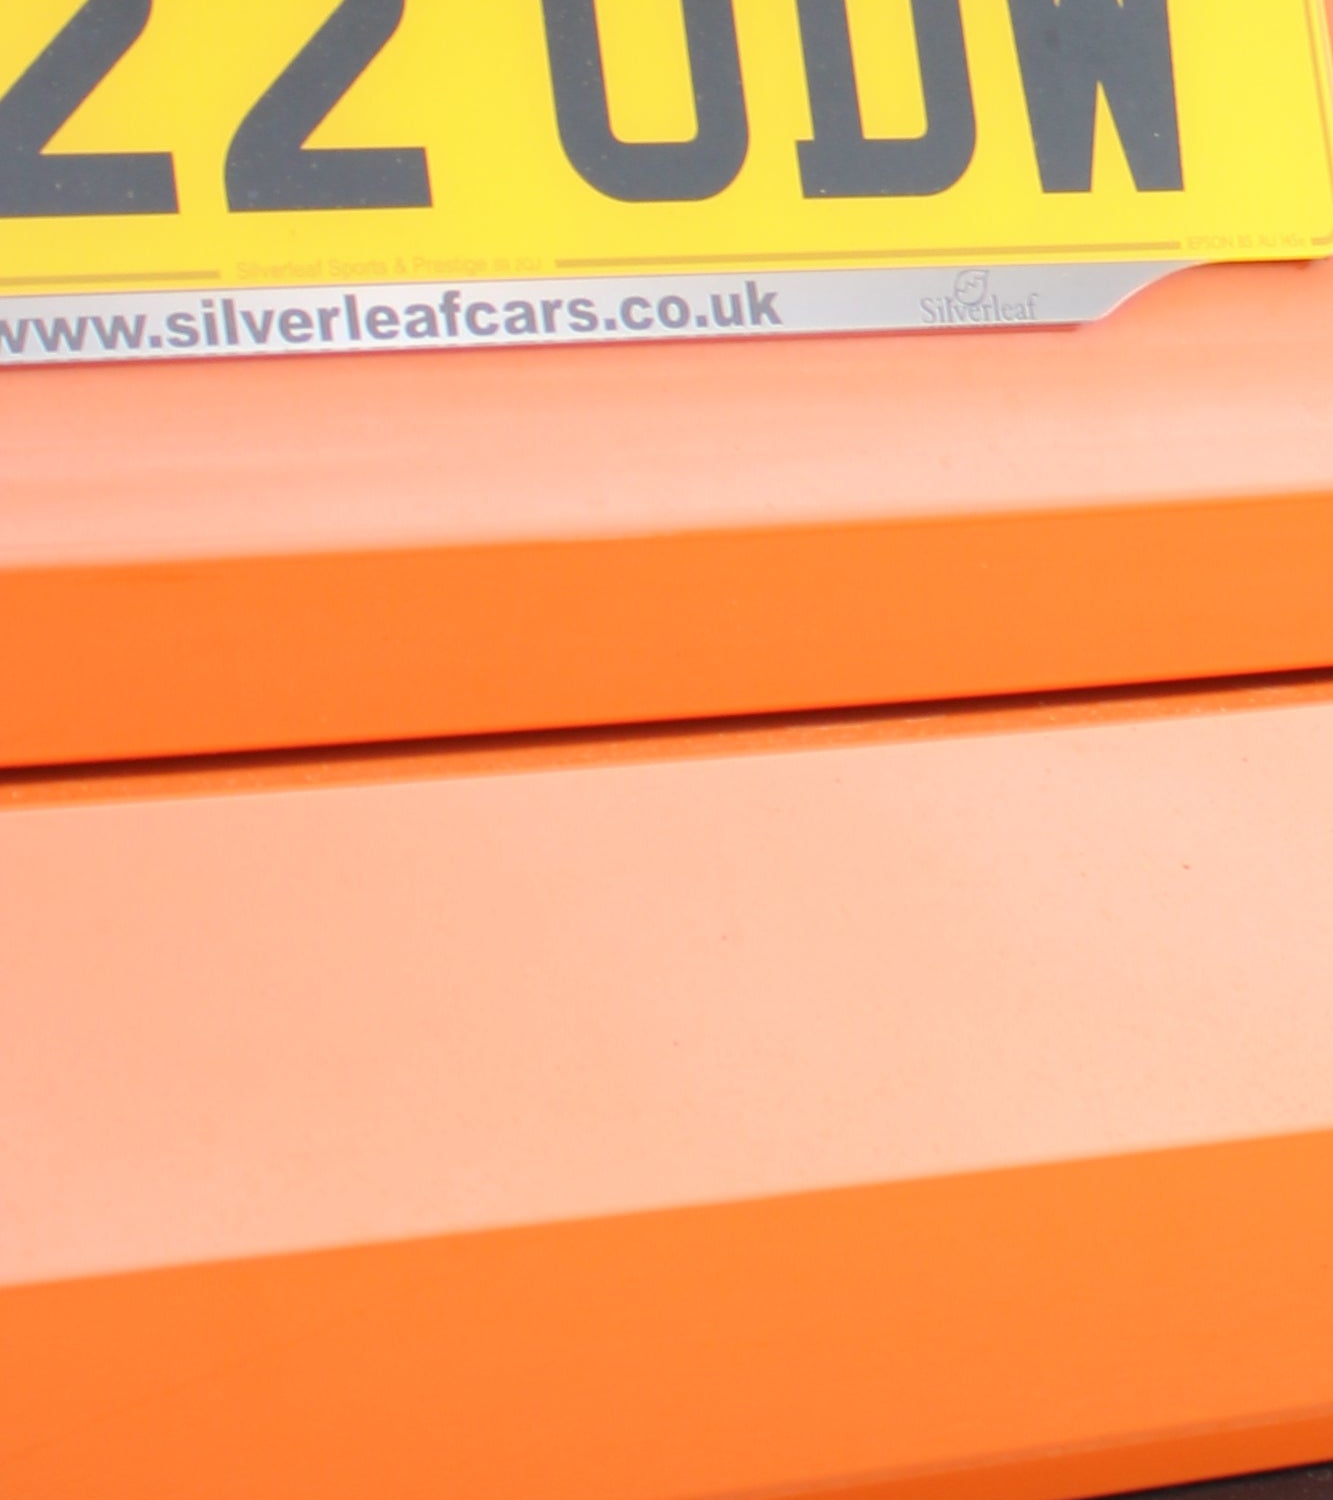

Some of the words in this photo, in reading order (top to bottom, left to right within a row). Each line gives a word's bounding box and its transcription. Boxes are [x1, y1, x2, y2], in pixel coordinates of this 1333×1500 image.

[236, 257, 323, 280] Silverleaf
[327, 256, 387, 278] Sports
[394, 255, 407, 275] &
[412, 255, 488, 277] Prestige
[919, 292, 1040, 324] Silverleaf
